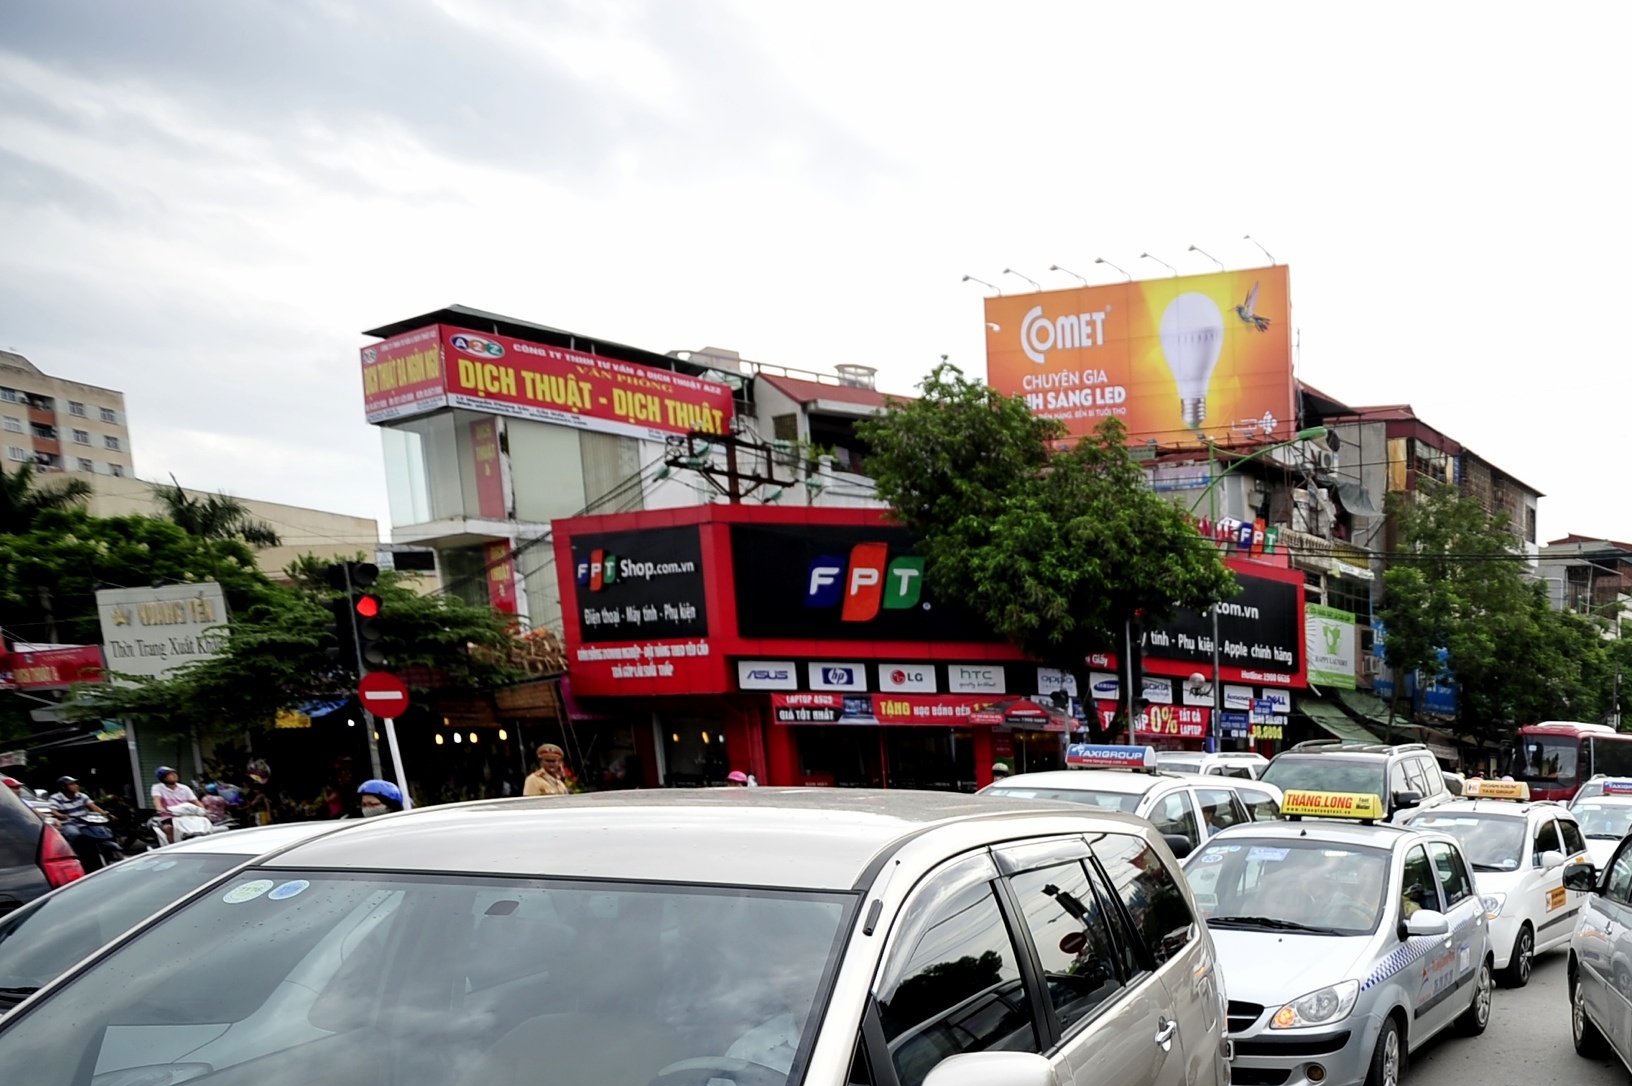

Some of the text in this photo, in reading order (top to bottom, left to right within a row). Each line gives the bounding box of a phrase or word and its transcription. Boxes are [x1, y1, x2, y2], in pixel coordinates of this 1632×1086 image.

[1020, 305, 1106, 364] COMET
[452, 335, 502, 357] A2Z
[1022, 369, 1108, 390] CHUYÊN GIA
[458, 359, 518, 397] DỊCH
[520, 370, 593, 413] THUẬT
[612, 387, 662, 424] DỊCH
[1047, 386, 1127, 410] SÁNG LED
[619, 558, 695, 581] Shop.com.vn
[110, 634, 195, 661] Thời Trang Xuất
[1177, 632, 1195, 655] Phụ
[1223, 640, 1248, 659] Apple
[1091, 653, 1109, 668] Giấy
[746, 669, 789, 681] ASUS
[907, 672, 924, 682] LG
[1040, 674, 1074, 684] oppo
[786, 695, 813, 704] LAPTOP
[879, 699, 911, 718] TẶNG
[779, 706, 835, 720] GIÁ TỐT NHẤT
[1150, 705, 1178, 733] 0%
[1180, 724, 1203, 736] LAPTOP
[1078, 750, 1143, 759] TAXIGROUP
